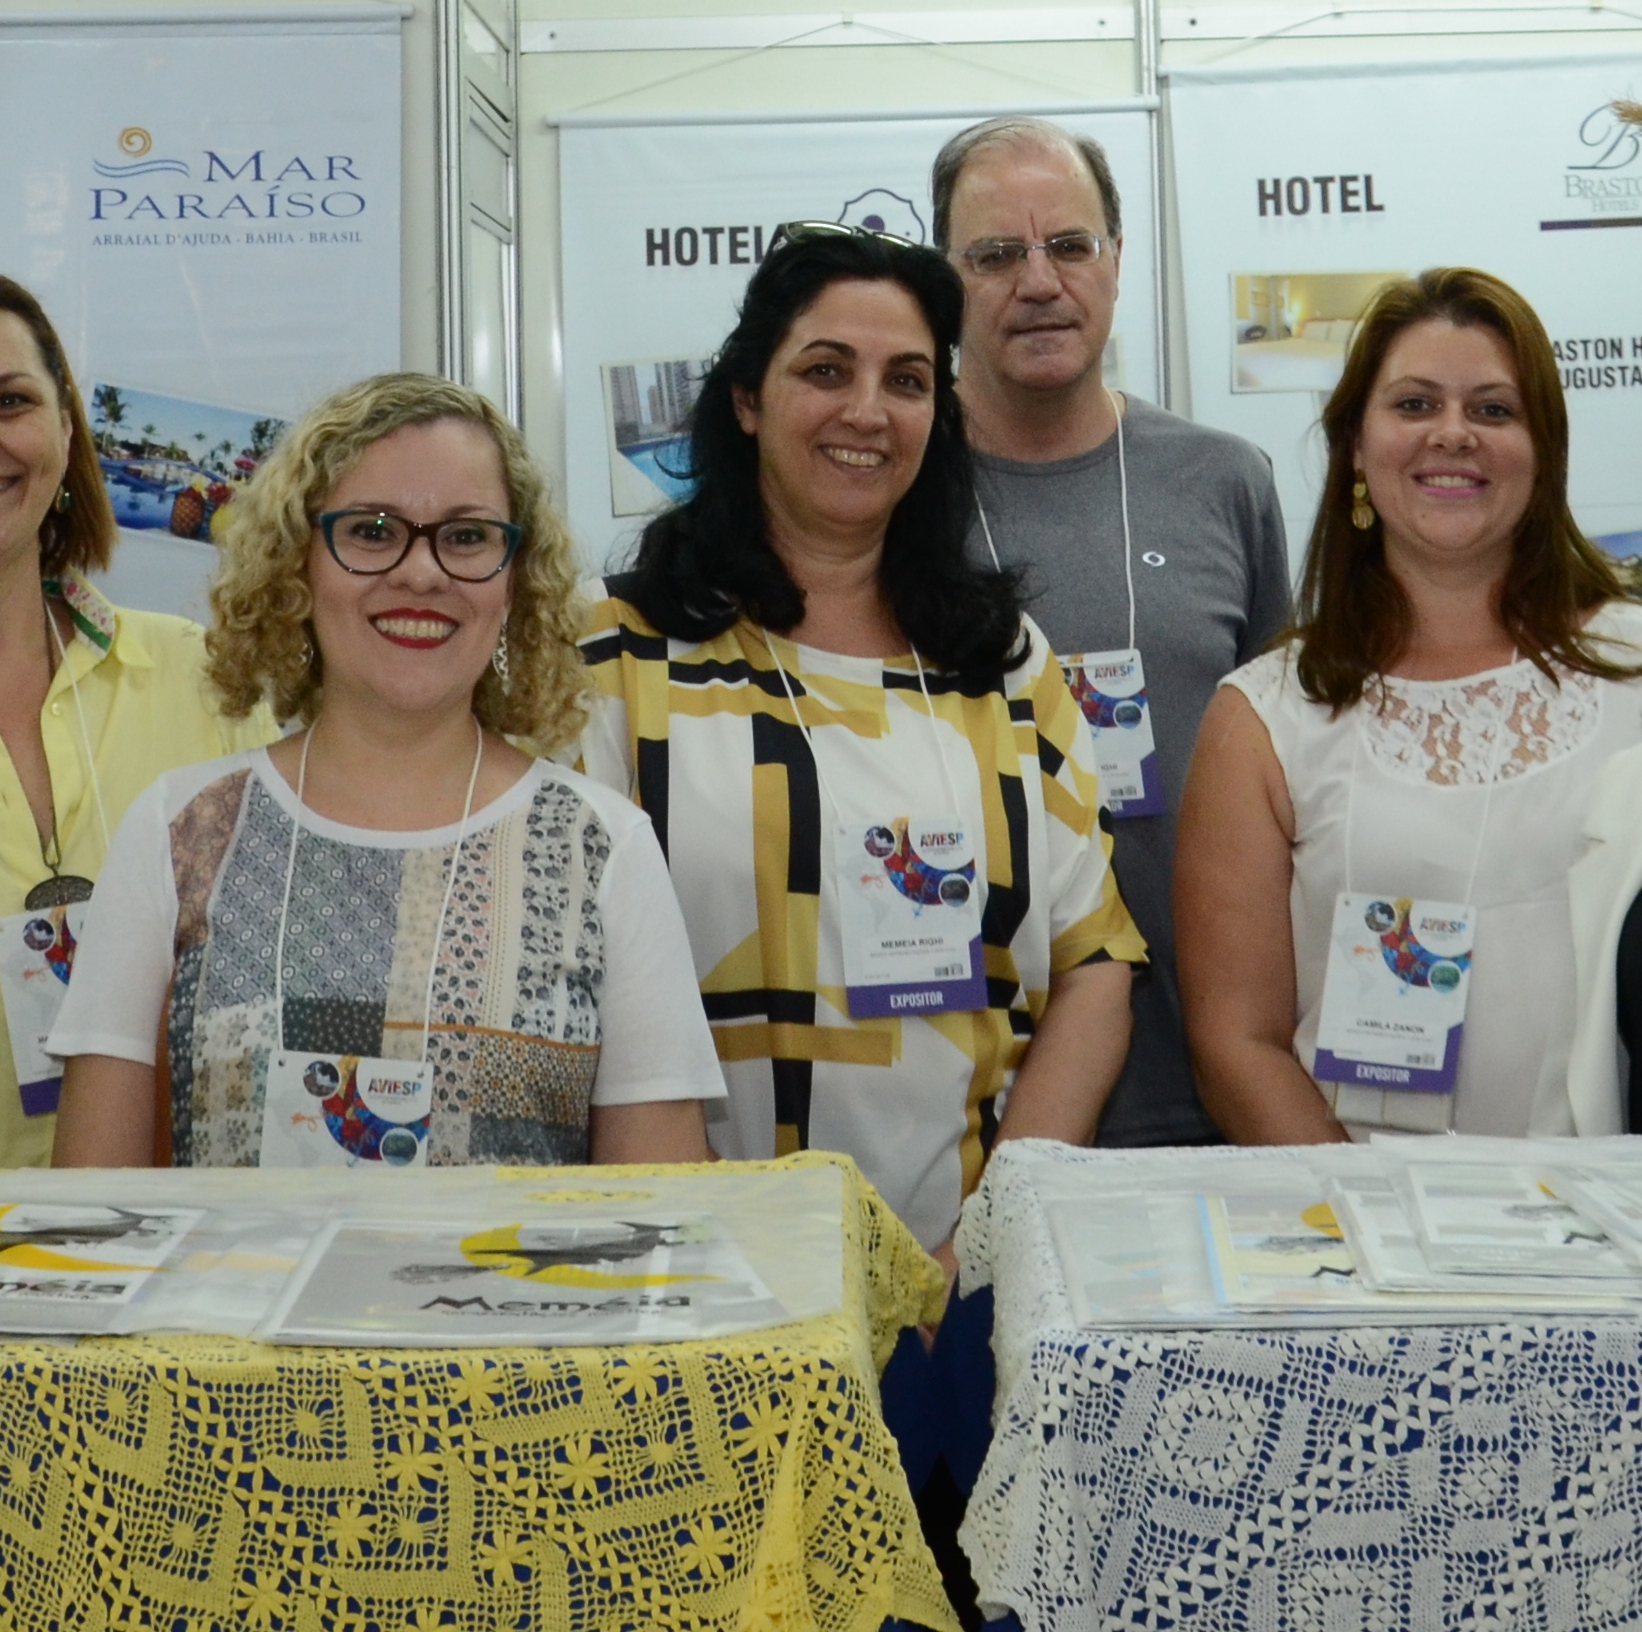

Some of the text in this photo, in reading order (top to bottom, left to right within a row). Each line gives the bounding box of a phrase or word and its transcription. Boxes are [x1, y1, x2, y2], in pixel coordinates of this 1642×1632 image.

[203, 150, 363, 183] MAR
[89, 185, 366, 220] PARAÍSO
[1258, 174, 1385, 218] HOTEL
[92, 234, 161, 247] ARRAIAL
[245, 233, 295, 245] BAHIA
[309, 231, 364, 244] BRASIL
[646, 225, 764, 267] HOTEL
[1553, 337, 1623, 362] ASTON
[889, 992, 944, 1008] EXPOSITOR
